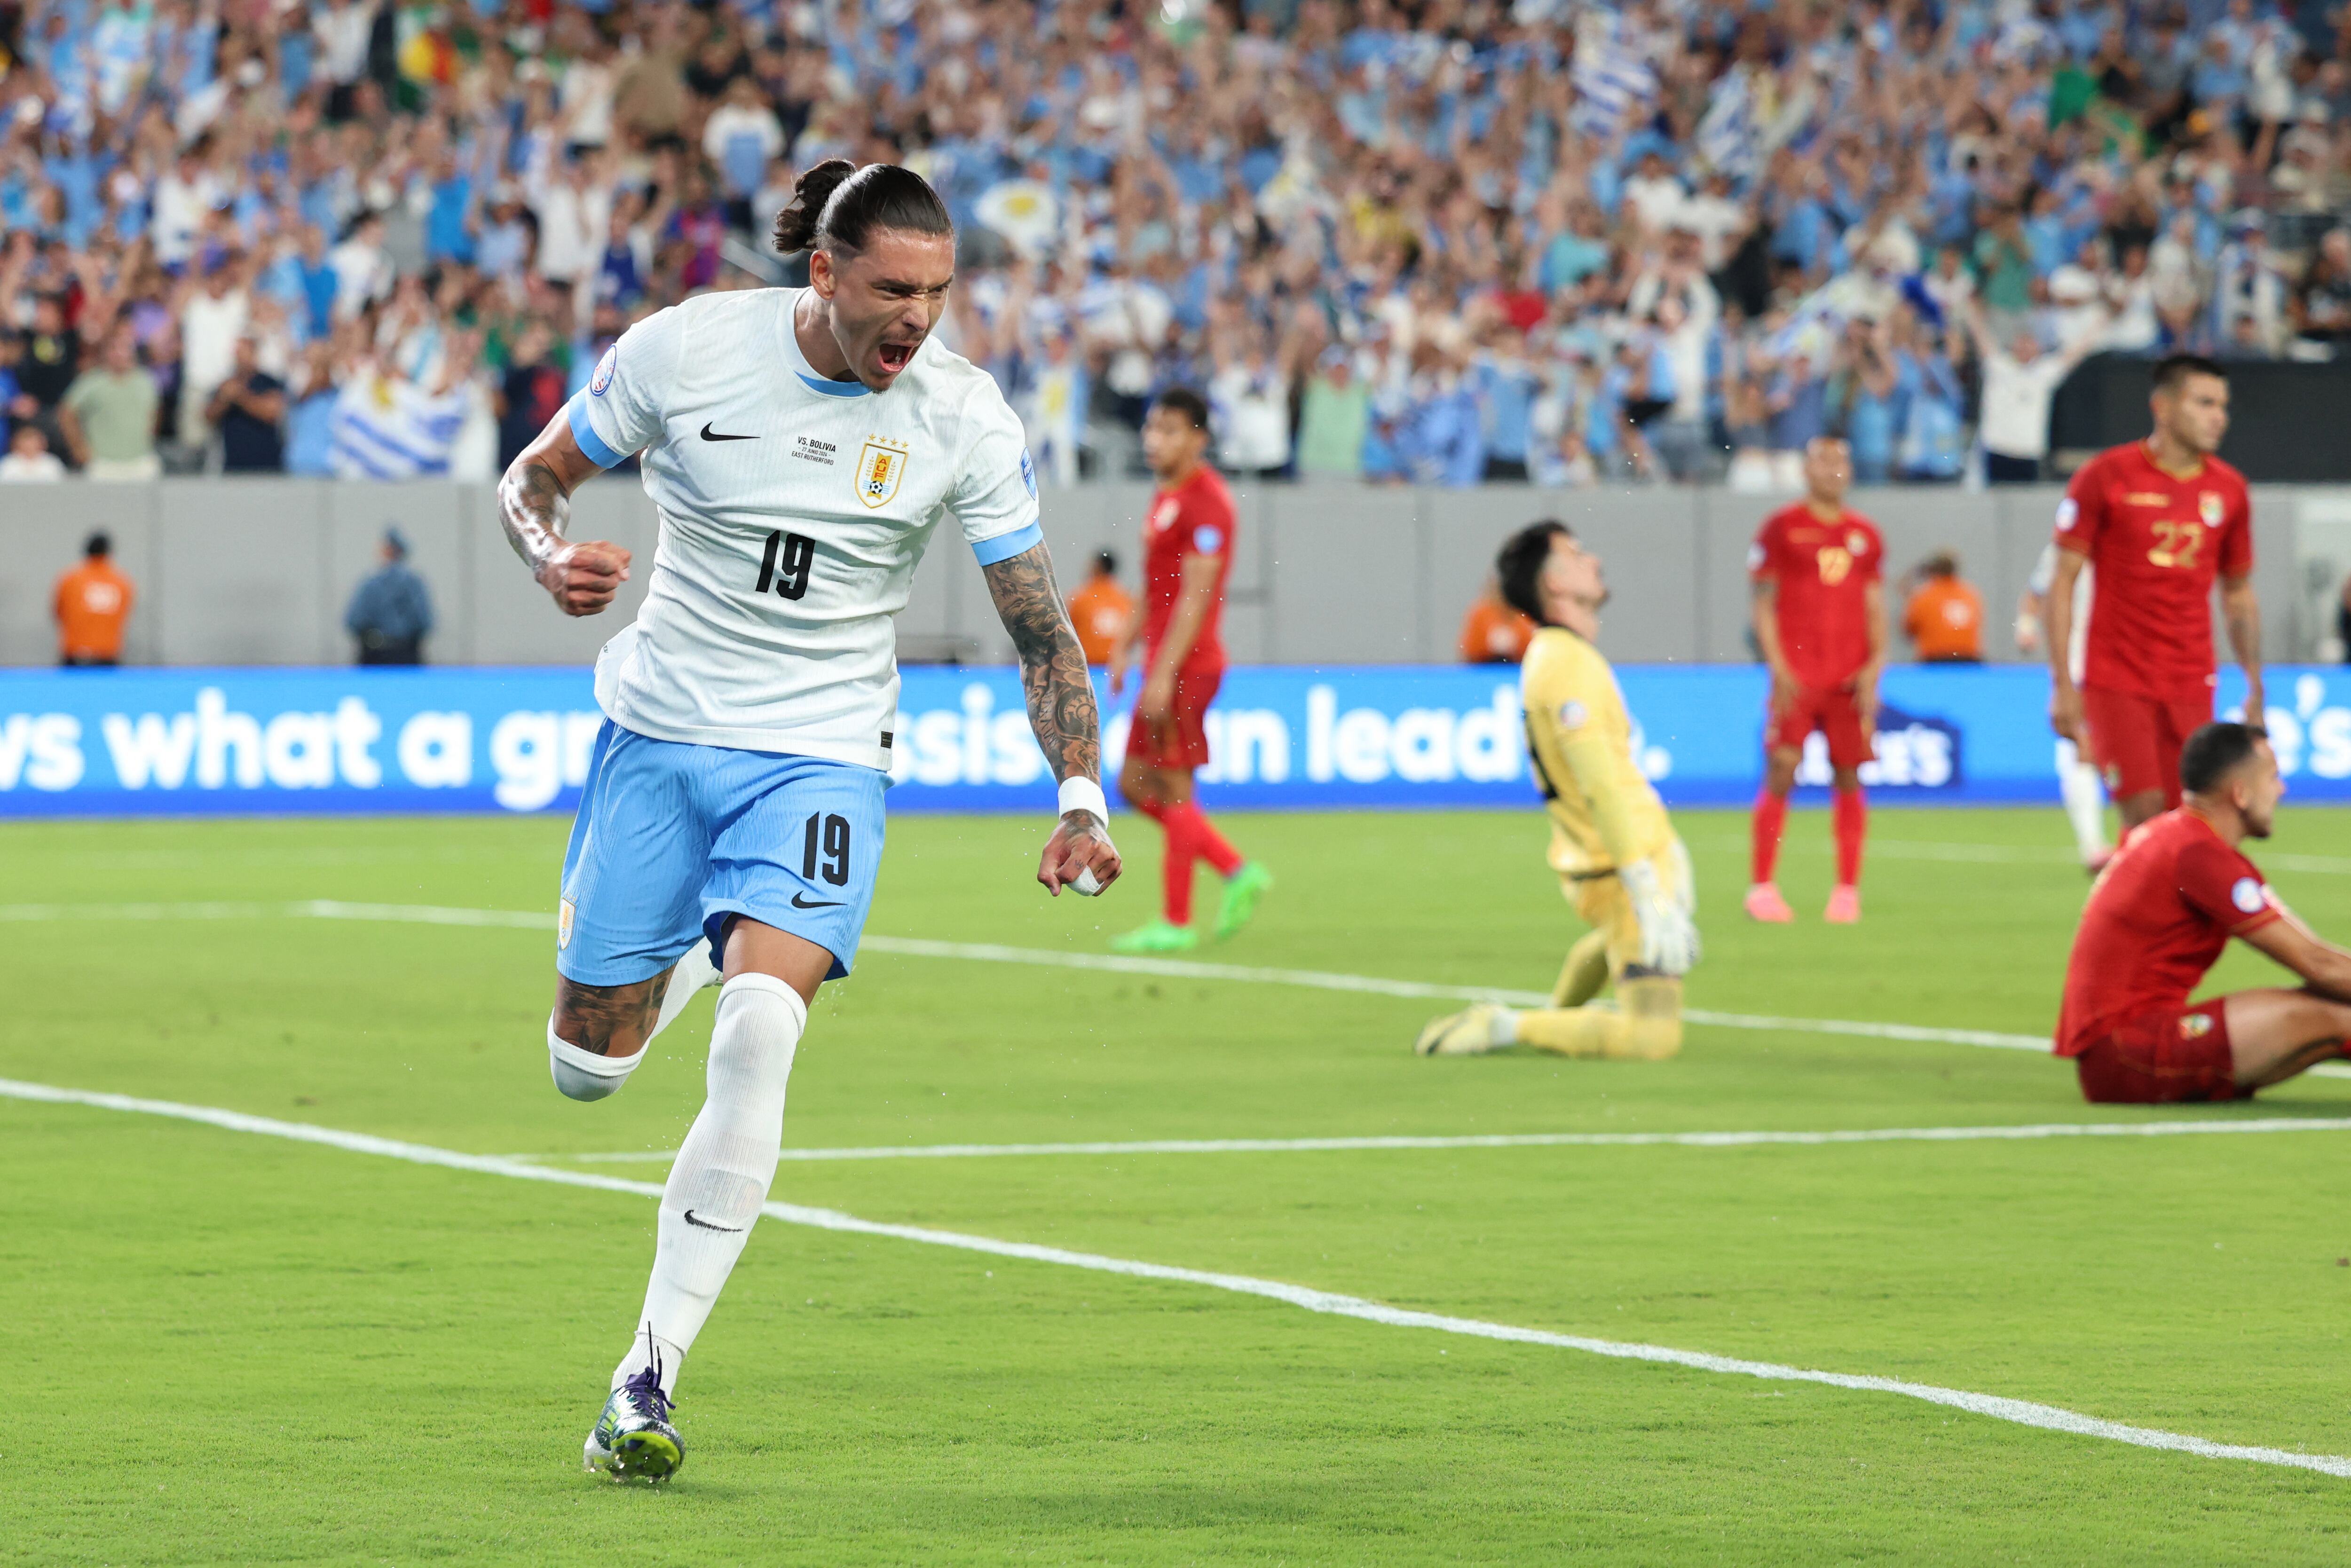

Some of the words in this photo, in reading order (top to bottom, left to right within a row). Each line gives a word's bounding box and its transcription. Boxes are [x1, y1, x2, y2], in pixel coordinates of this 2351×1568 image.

[798, 436, 808, 446] VS.
[810, 440, 836, 452] BOLIVIA
[804, 454, 834, 465] RUTHERFORD
[874, 458, 887, 478] AUF
[755, 530, 816, 601] 19
[2147, 519, 2205, 568] 22
[101, 686, 382, 790] what
[397, 710, 472, 789] a
[489, 710, 604, 811] gr
[893, 683, 1041, 786] ssis
[1306, 684, 1523, 783] lead
[803, 811, 850, 887] 19
